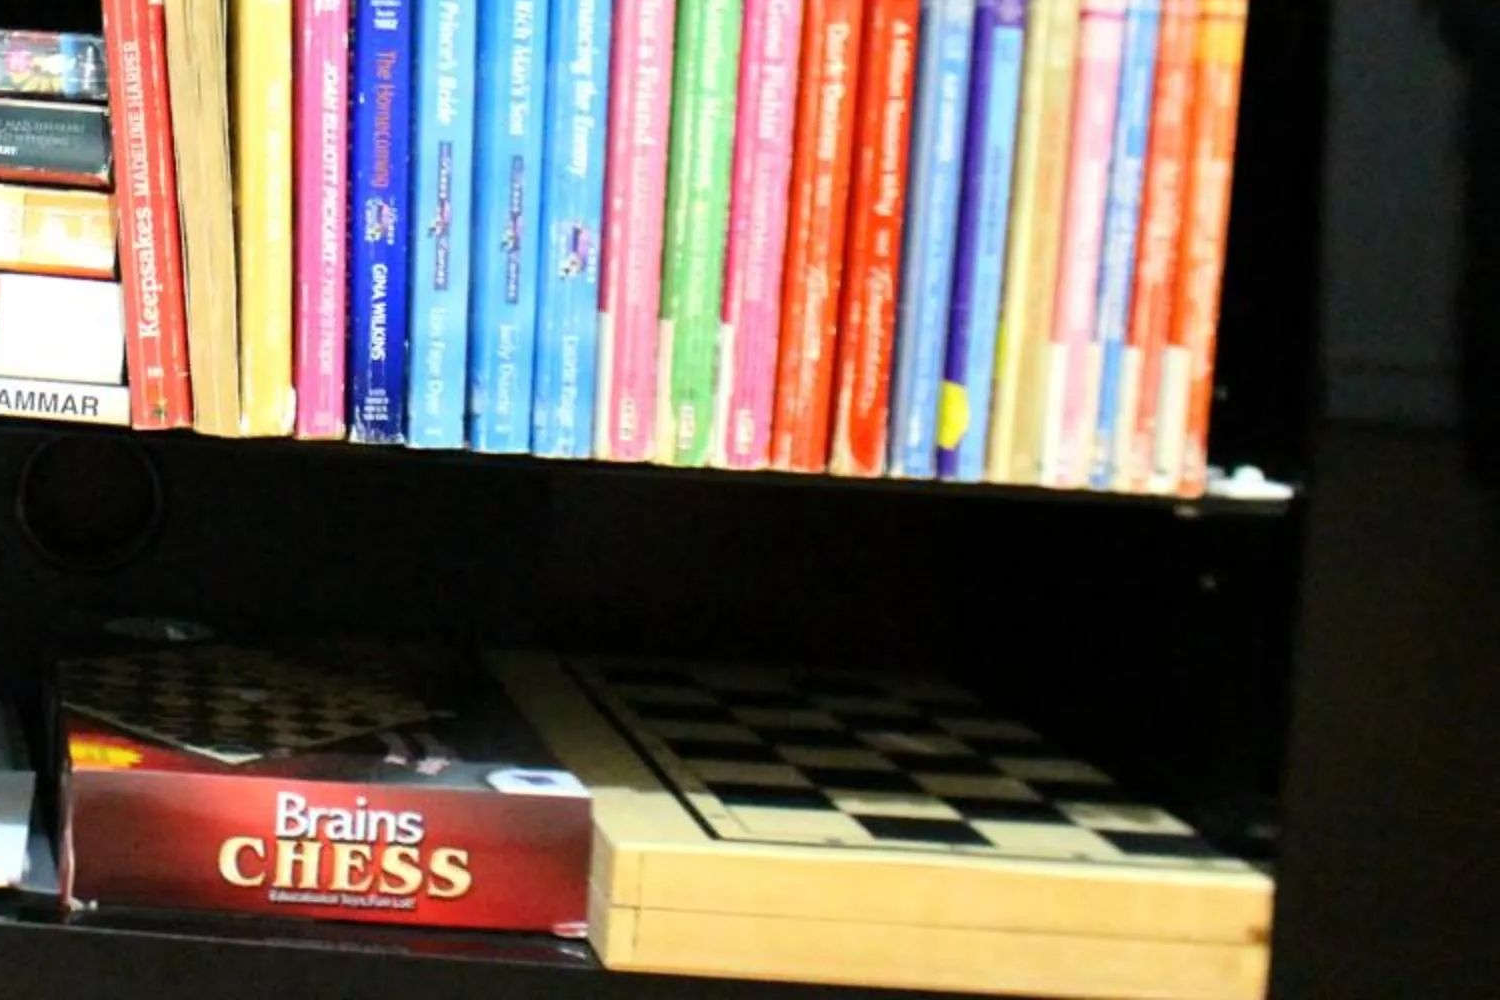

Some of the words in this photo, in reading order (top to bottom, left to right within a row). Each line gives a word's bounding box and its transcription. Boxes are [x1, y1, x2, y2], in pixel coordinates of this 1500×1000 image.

[374, 49, 396, 79] The
[437, 0, 459, 71] Prince's
[121, 40, 143, 108] HARPER
[436, 73, 457, 126] Bride
[573, 79, 596, 111] the
[632, 65, 659, 145] Friend
[319, 112, 339, 184] ELLIOTT
[370, 82, 394, 189] Homecoming
[509, 102, 529, 137] Son
[126, 111, 151, 197] MADELINE
[131, 206, 164, 339] Keepsakes
[370, 263, 389, 299] GINA
[369, 300, 388, 361] WILKINS
[275, 791, 425, 846] Brains
[217, 835, 472, 897] CHESS
